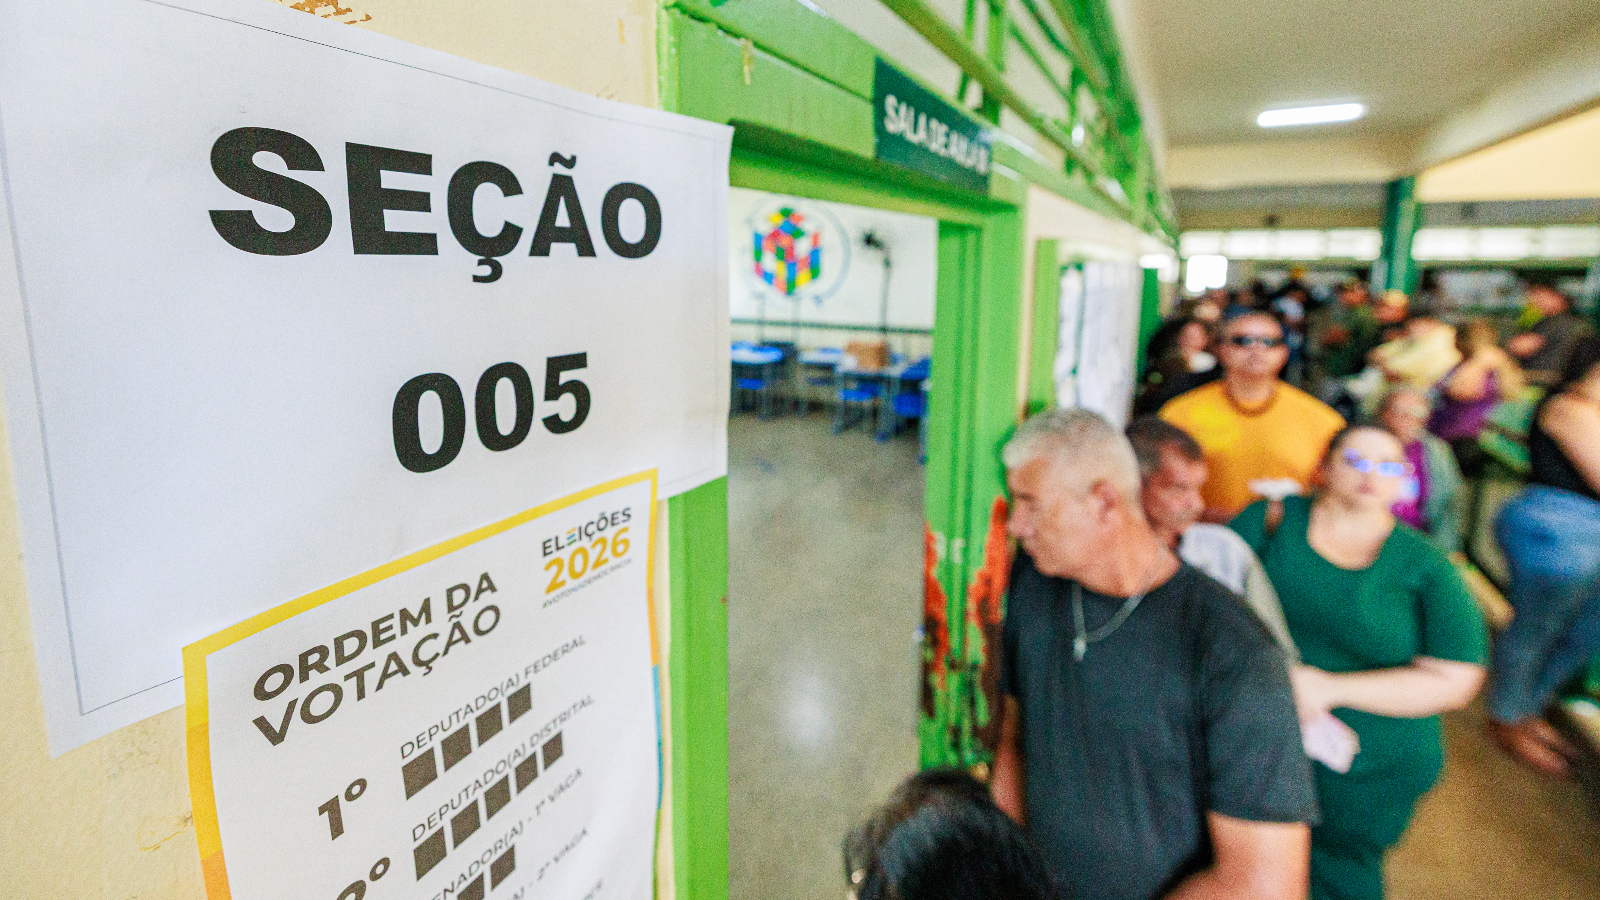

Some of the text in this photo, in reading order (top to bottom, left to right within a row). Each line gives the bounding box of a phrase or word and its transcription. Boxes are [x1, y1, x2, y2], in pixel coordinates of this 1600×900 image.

[208, 127, 662, 284] SEÇÃO
[392, 352, 591, 474] 005
[542, 507, 631, 557] ELEIÇÕES
[544, 527, 630, 595] 2026
[252, 605, 500, 747] VOTAÇÃO
[253, 572, 497, 701] ORDEM DA
[401, 635, 587, 759] DEPUTADO(A) FEDERAL
[412, 695, 595, 842] DEPUTADO(A) DISTRITAL
[549, 768, 582, 802] VAGA
